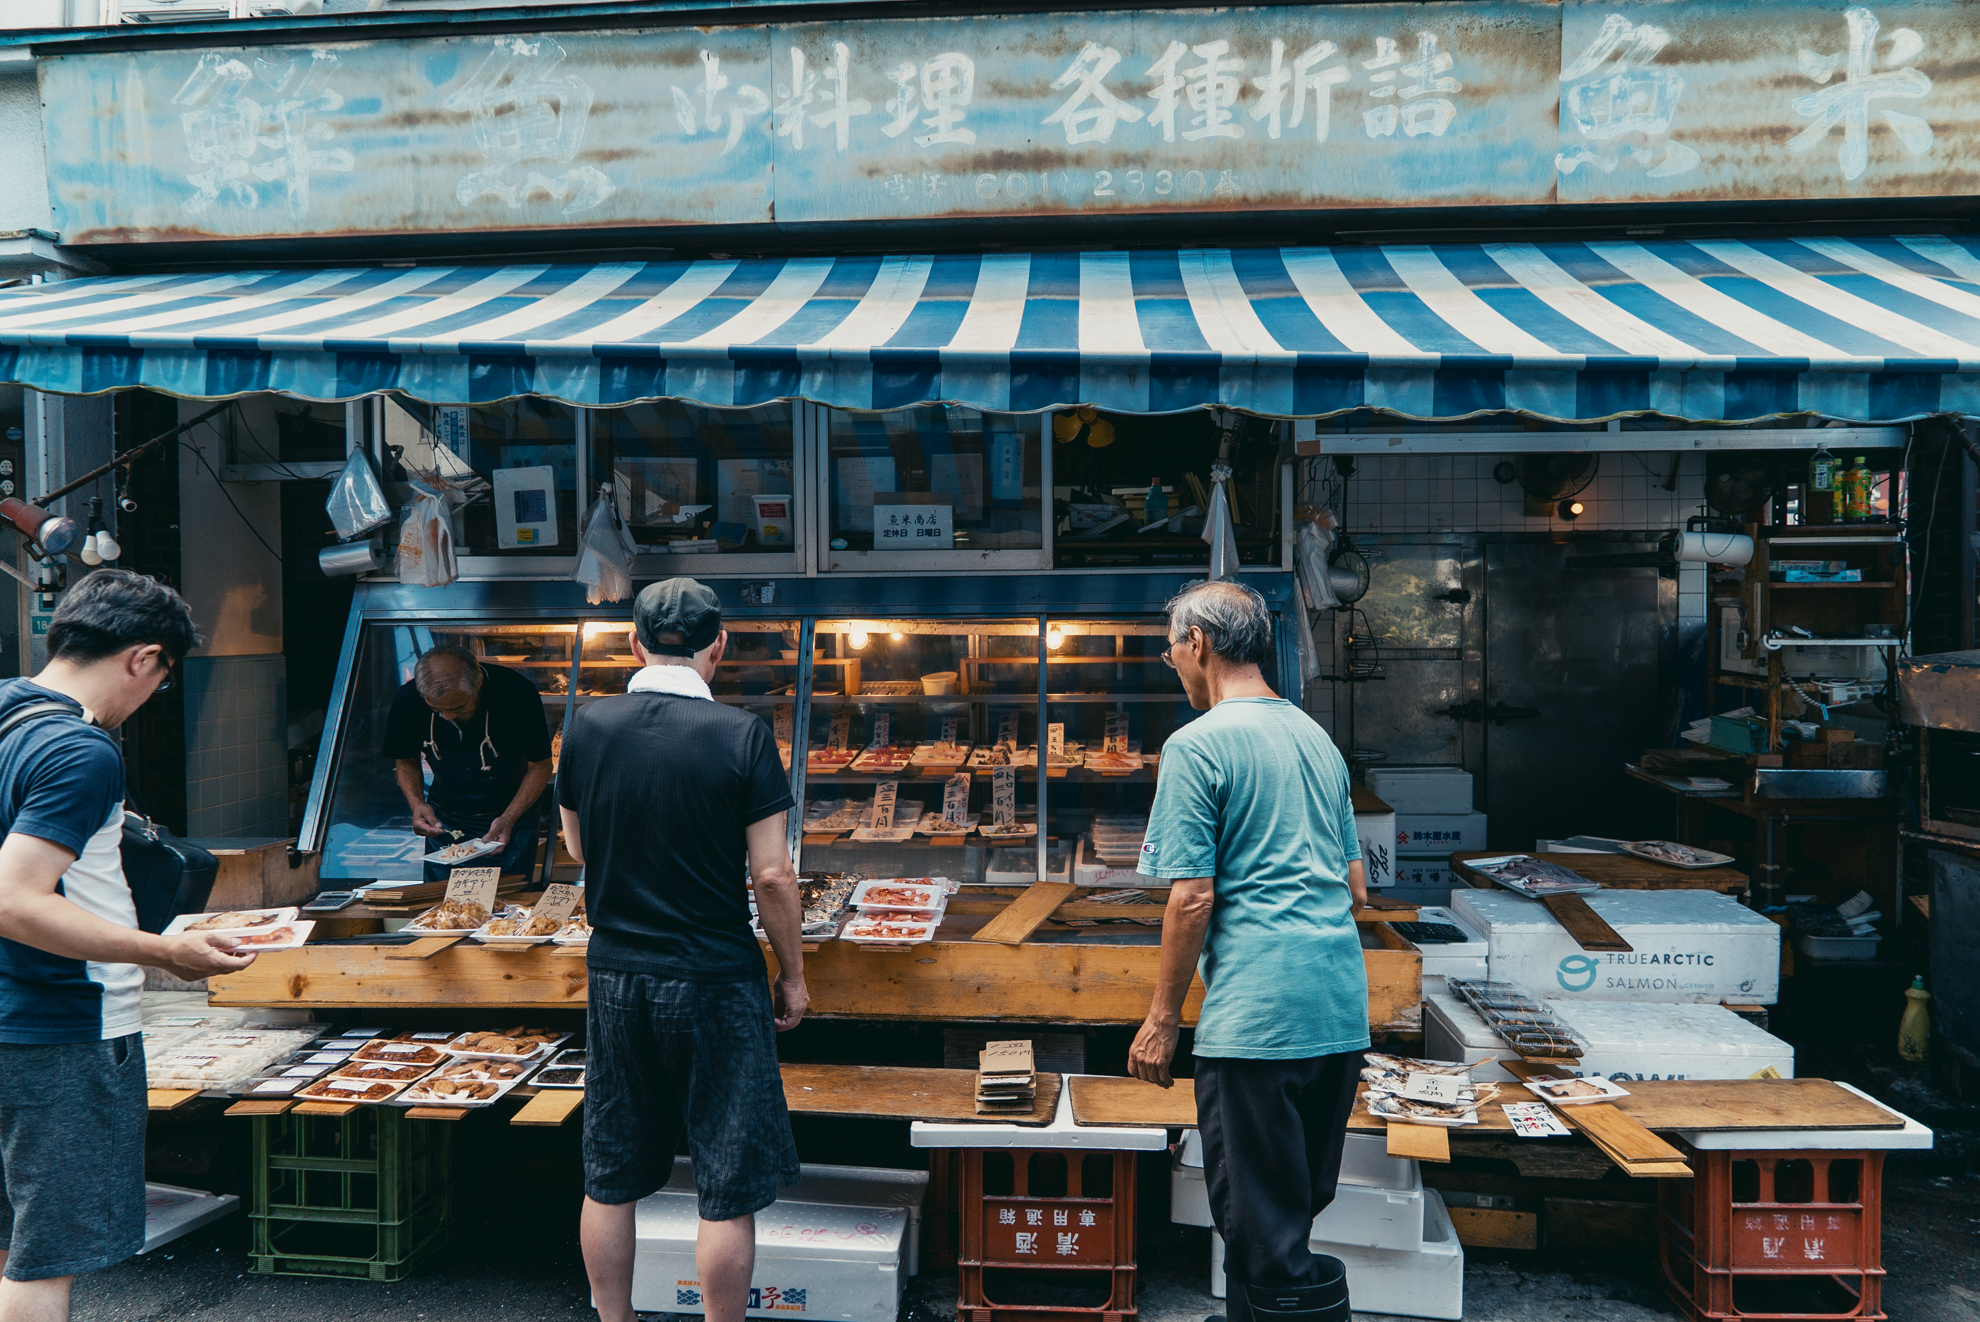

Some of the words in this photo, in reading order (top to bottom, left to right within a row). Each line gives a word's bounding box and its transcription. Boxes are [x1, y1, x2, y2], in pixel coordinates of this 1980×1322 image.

[1042, 31, 1462, 146] 各種折詰
[888, 513, 937, 526] 魚米商店
[883, 528, 908, 538] 定休日
[916, 528, 941, 537] 日曜日
[1413, 831, 1461, 841] 鈴木屋水産
[1606, 953, 1715, 966] TRUEARCTIC
[1606, 977, 1677, 990] SALMON
[999, 1208, 1096, 1228] 専用通箱
[1015, 1232, 1079, 1256] 清酒
